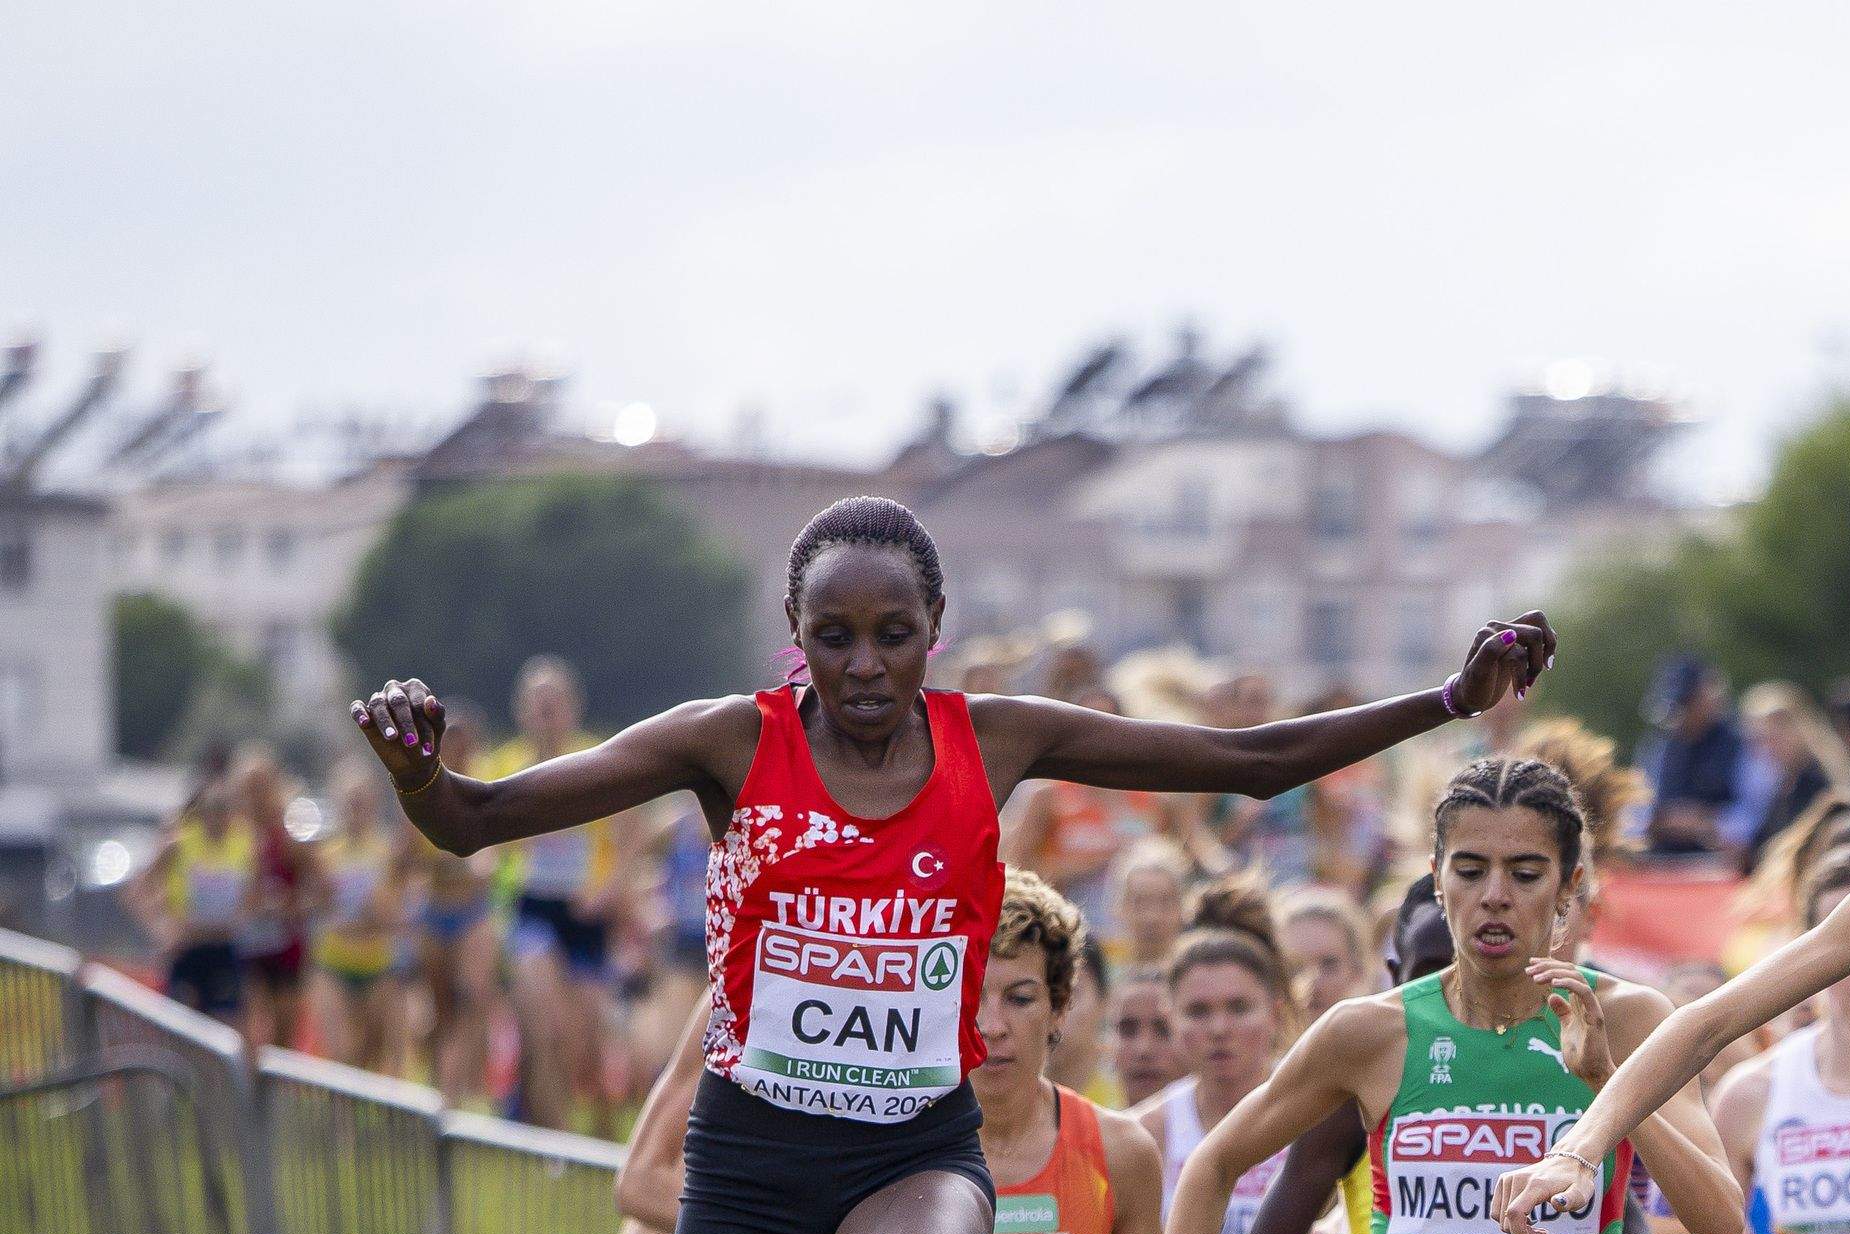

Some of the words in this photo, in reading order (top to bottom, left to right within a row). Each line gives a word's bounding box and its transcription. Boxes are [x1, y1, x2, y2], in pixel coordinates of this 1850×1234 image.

[769, 887, 958, 934] TÜRKİYE
[763, 935, 914, 986] SPAR
[790, 1000, 922, 1053] CAN
[787, 1060, 792, 1075] I
[797, 1061, 842, 1082] RUN
[1430, 1073, 1453, 1084] FPA
[753, 1078, 877, 1116] ANTALYA
[883, 1092, 944, 1117] 202
[1395, 1123, 1543, 1159] SPAR
